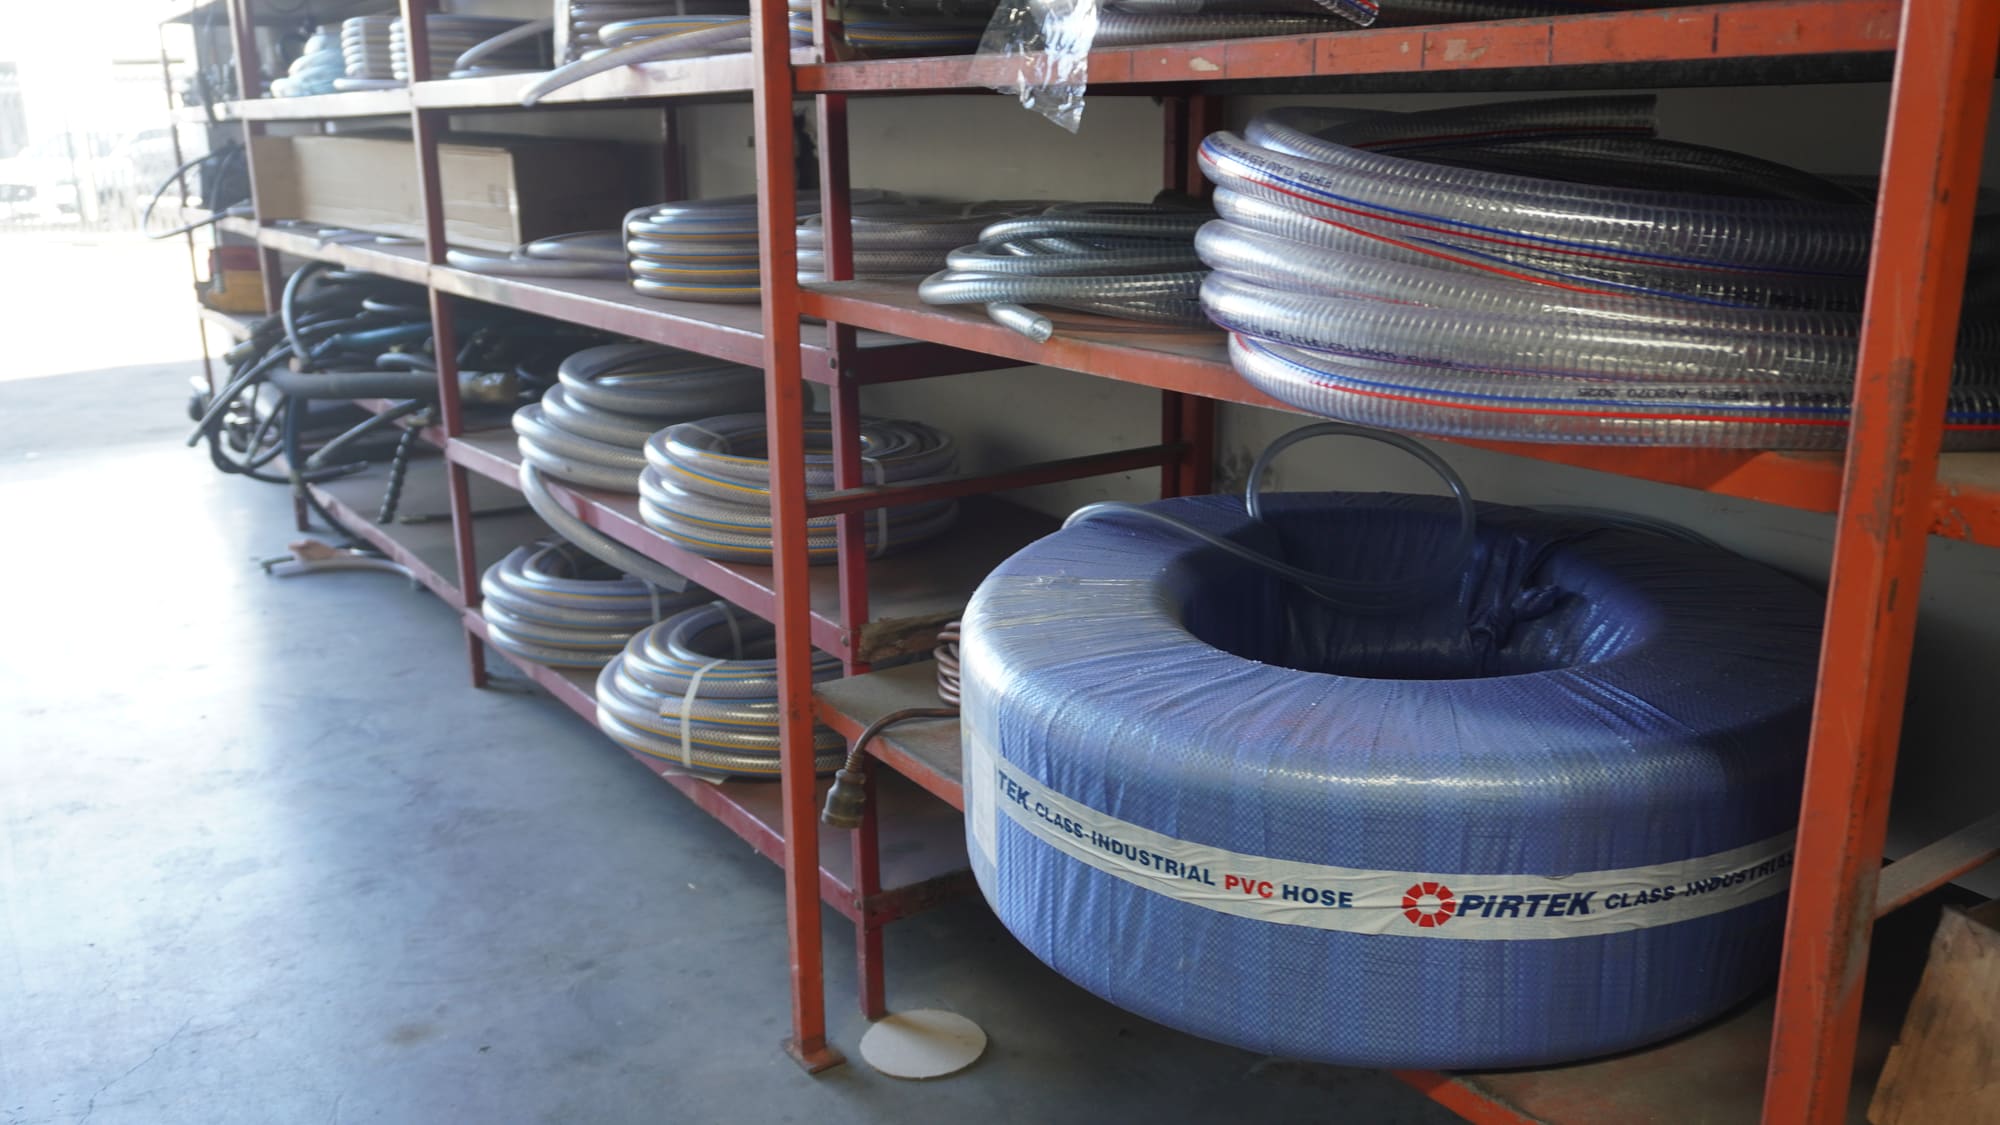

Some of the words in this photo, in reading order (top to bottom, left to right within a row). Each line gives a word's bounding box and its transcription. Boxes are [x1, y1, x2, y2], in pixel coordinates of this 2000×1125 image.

[999, 770, 1030, 811] TEK
[1224, 874, 1274, 898] PVC
[1282, 884, 1353, 908] HOSE
[1456, 891, 1597, 918] PIRTEK
[1604, 885, 1676, 910] CLASS
